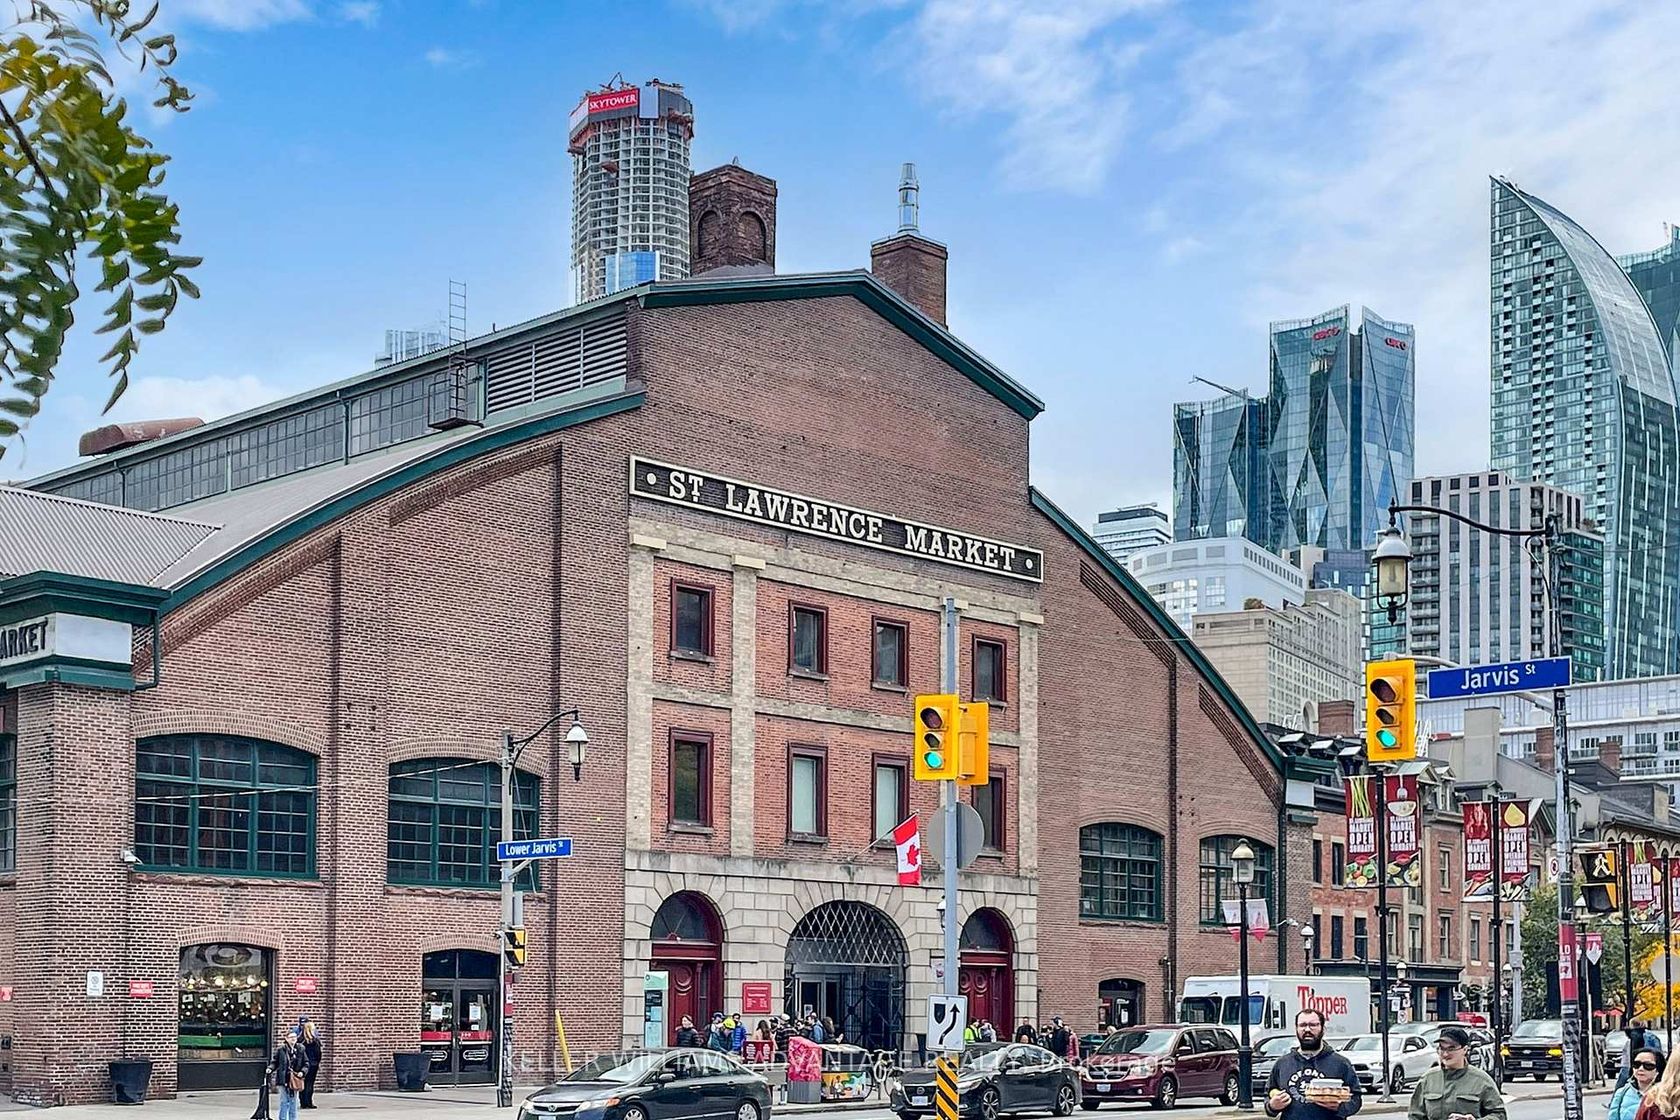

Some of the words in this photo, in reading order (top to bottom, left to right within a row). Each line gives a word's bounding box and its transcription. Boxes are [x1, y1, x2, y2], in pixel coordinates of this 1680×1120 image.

[589, 94, 636, 110] SKYTOWER
[725, 484, 883, 543] LAWRENCE
[904, 524, 1015, 571] MARKET
[1461, 666, 1519, 690] Jarvis
[1524, 663, 1536, 675] St
[1350, 832, 1375, 845] OPEN
[1390, 831, 1416, 843] OPEN
[505, 844, 530, 856] Lower
[532, 841, 556, 854] Jarvis
